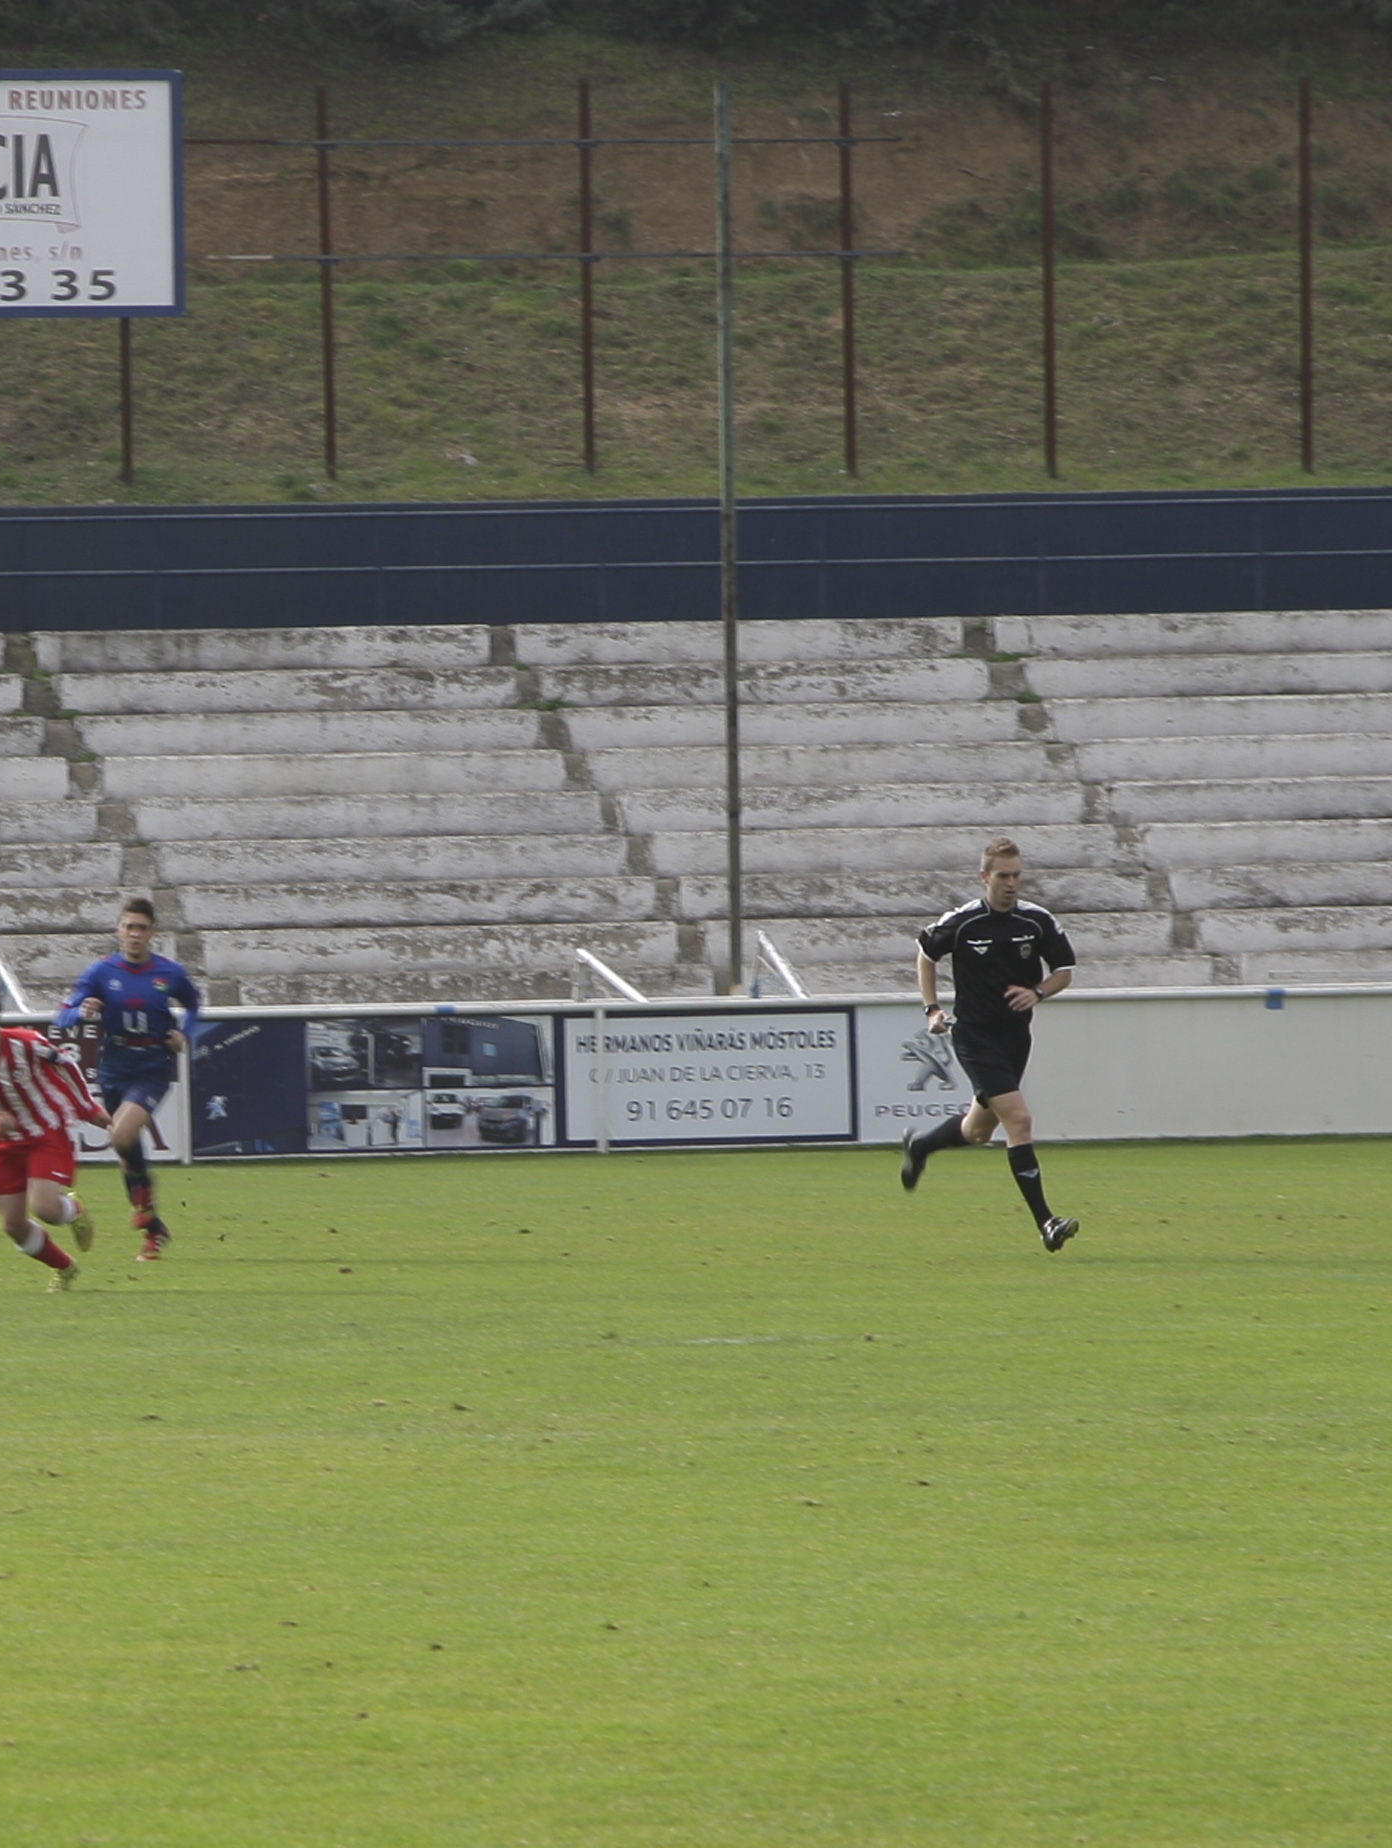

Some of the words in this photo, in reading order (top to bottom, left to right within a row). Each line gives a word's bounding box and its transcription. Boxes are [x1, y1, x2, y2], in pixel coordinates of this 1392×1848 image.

[10, 90, 146, 110] REUNIONES
[50, 241, 84, 264] s/n
[51, 269, 117, 301] 35
[576, 1033, 672, 1053] HERMANOS
[749, 1027, 837, 1050] MÓSTOLES
[617, 1067, 665, 1084] JUAN
[670, 1066, 696, 1082] DE
[700, 1065, 724, 1081] LA
[726, 1064, 798, 1082] CIERVA,
[626, 1100, 657, 1121] 91
[666, 1100, 714, 1120] 645
[720, 1098, 753, 1119] 07
[766, 1097, 793, 1117] 16
